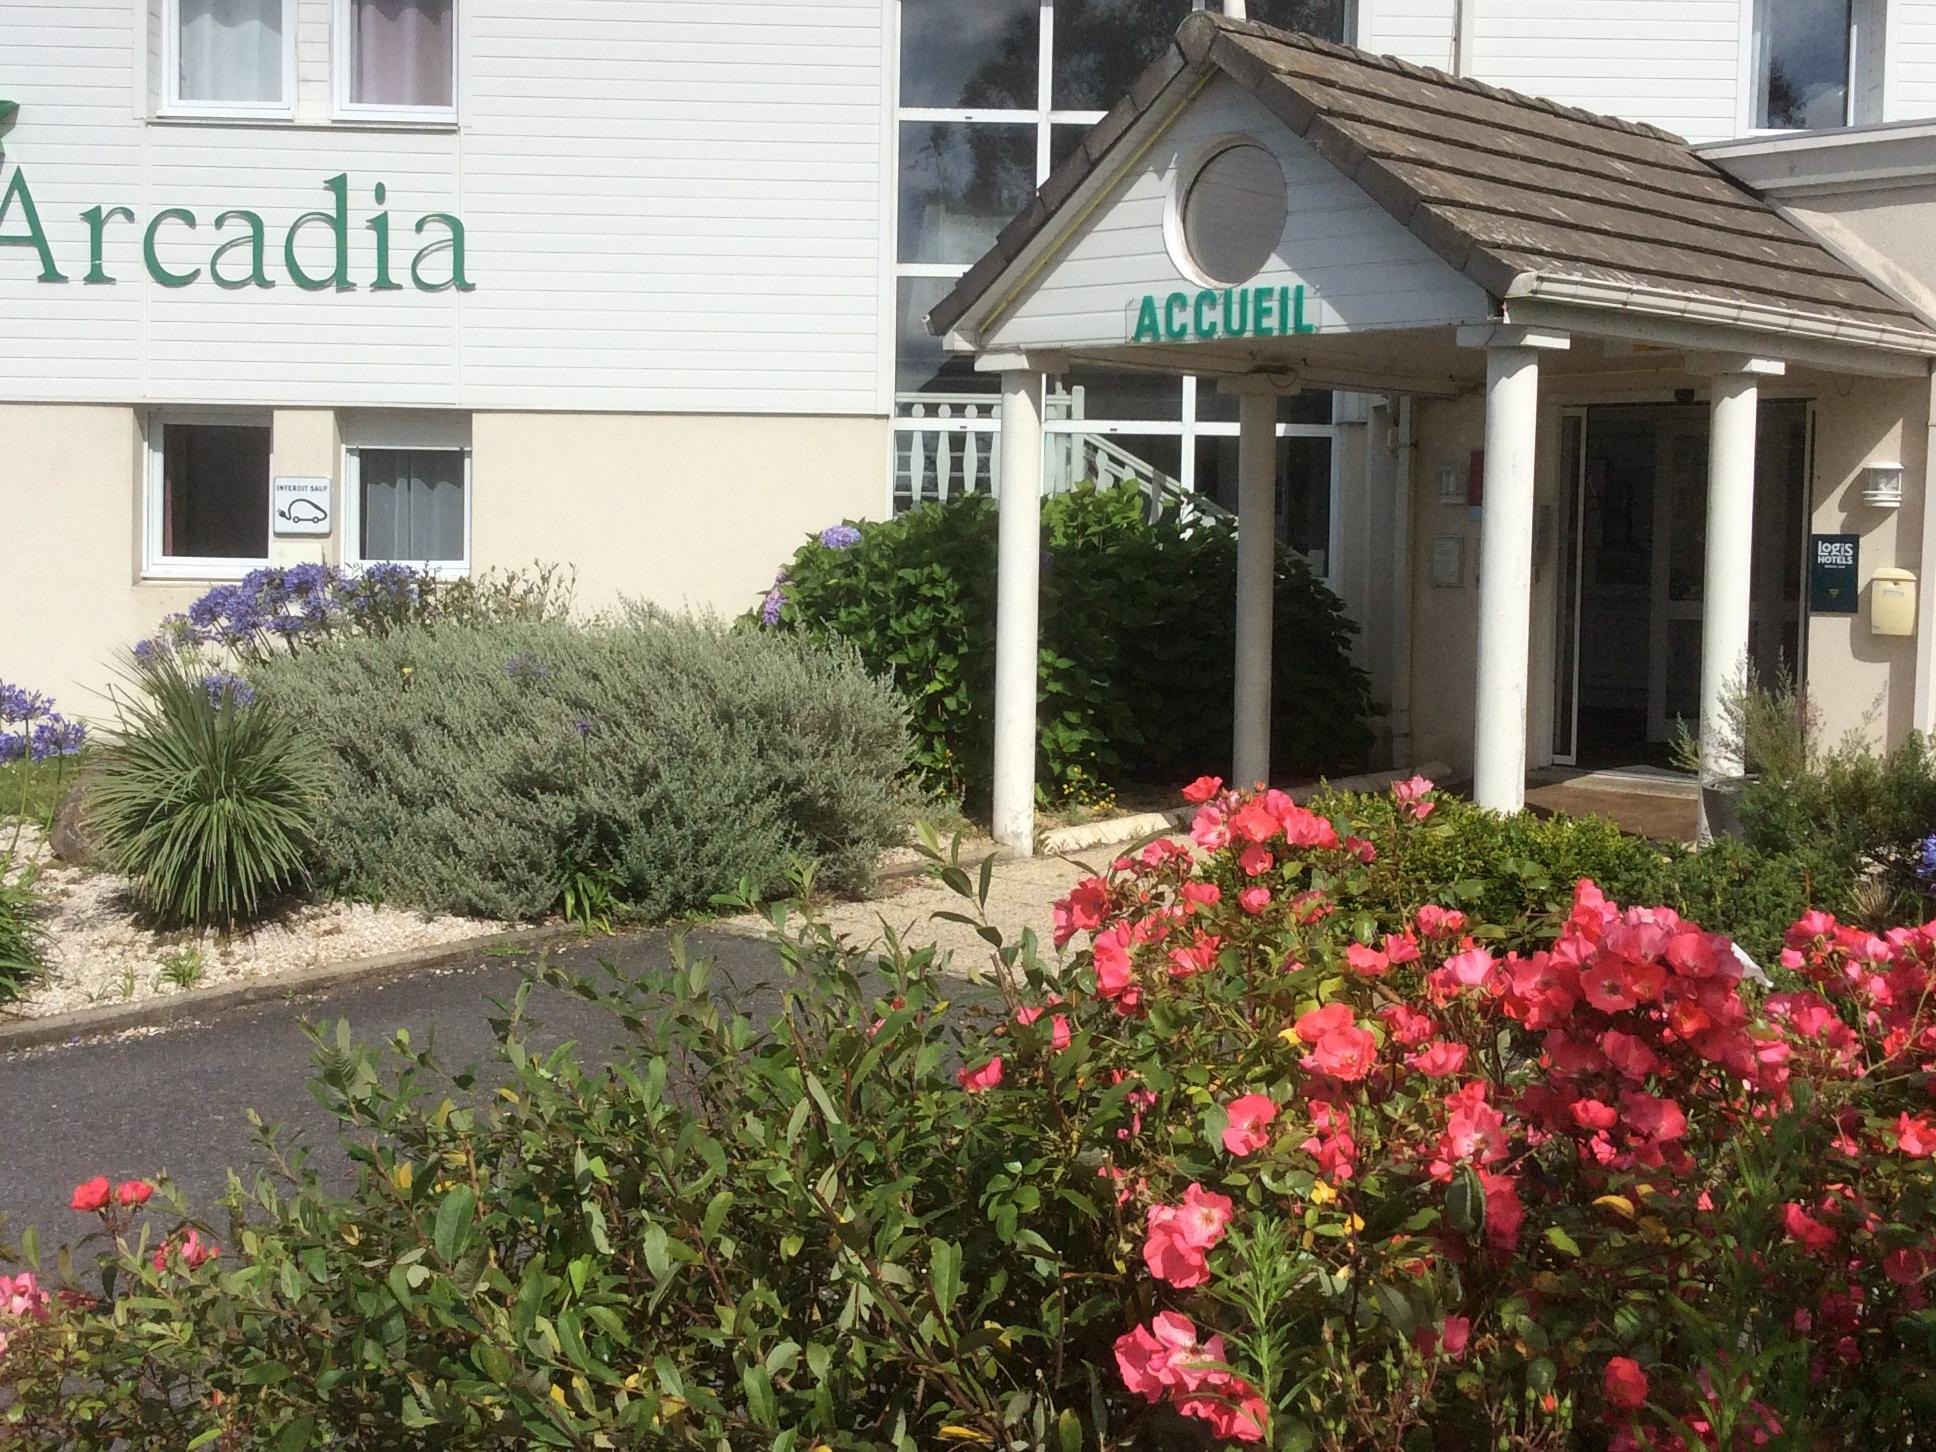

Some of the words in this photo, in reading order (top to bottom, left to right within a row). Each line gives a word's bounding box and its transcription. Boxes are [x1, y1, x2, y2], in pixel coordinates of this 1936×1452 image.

[0, 165, 476, 292] Arcadia
[1134, 284, 1315, 342] ACCUEIL
[1817, 556, 1853, 565] HOTELS
